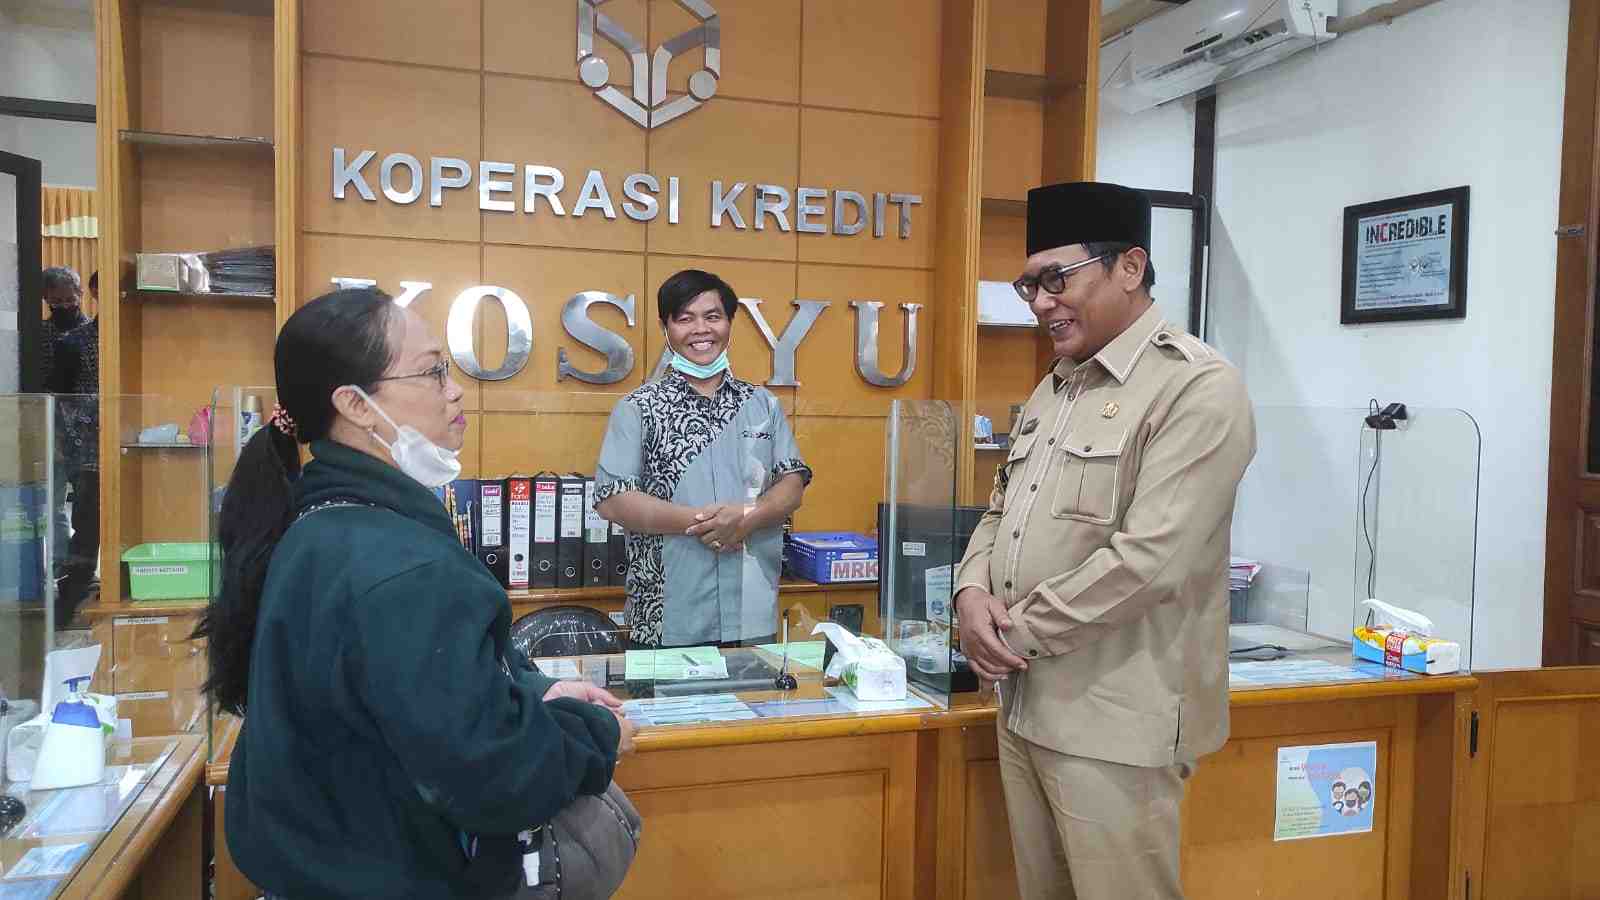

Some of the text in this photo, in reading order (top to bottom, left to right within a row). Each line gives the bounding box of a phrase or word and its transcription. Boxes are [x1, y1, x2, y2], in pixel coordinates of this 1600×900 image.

[331, 147, 923, 240] KOPERASI KREDIT
[1365, 214, 1447, 244] INCREDIBLE
[331, 276, 924, 388] OSYU
[832, 562, 879, 578] MRK
